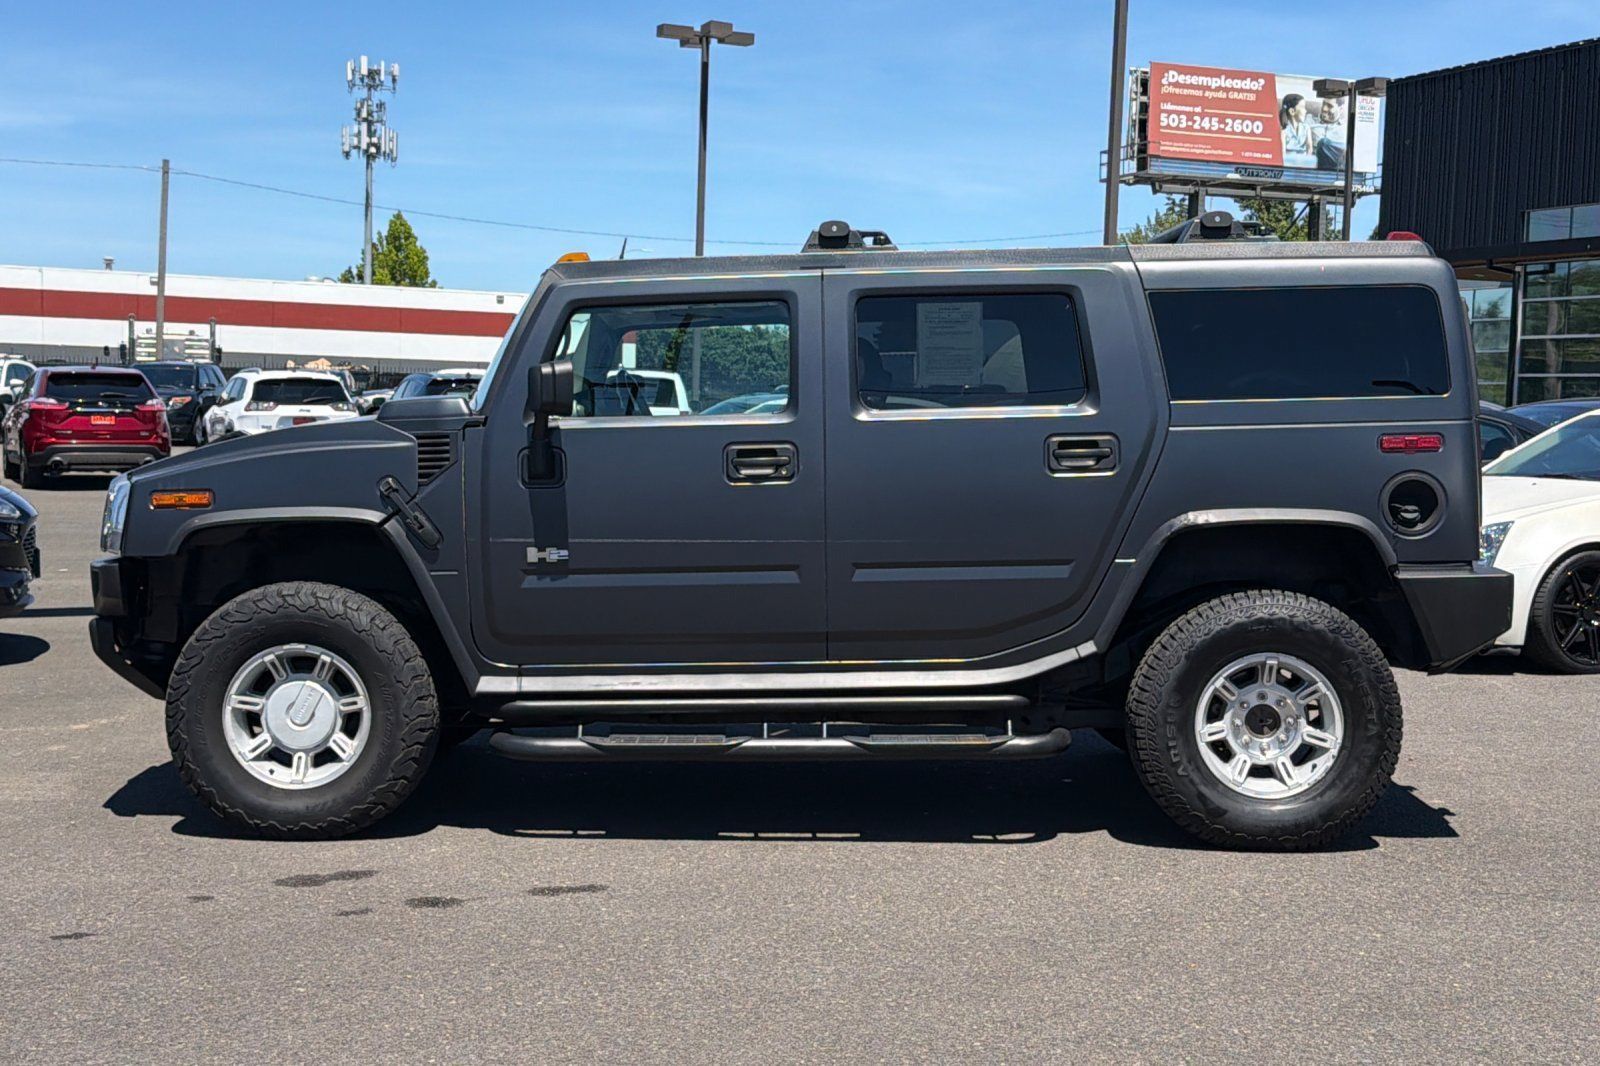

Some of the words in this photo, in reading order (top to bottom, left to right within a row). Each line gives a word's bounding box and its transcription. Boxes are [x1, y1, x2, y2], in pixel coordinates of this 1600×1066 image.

[1161, 70, 1265, 90] ¿Desempleado?
[1204, 90, 1226, 99] ayuda
[1160, 113, 1263, 134] 503-245-2600
